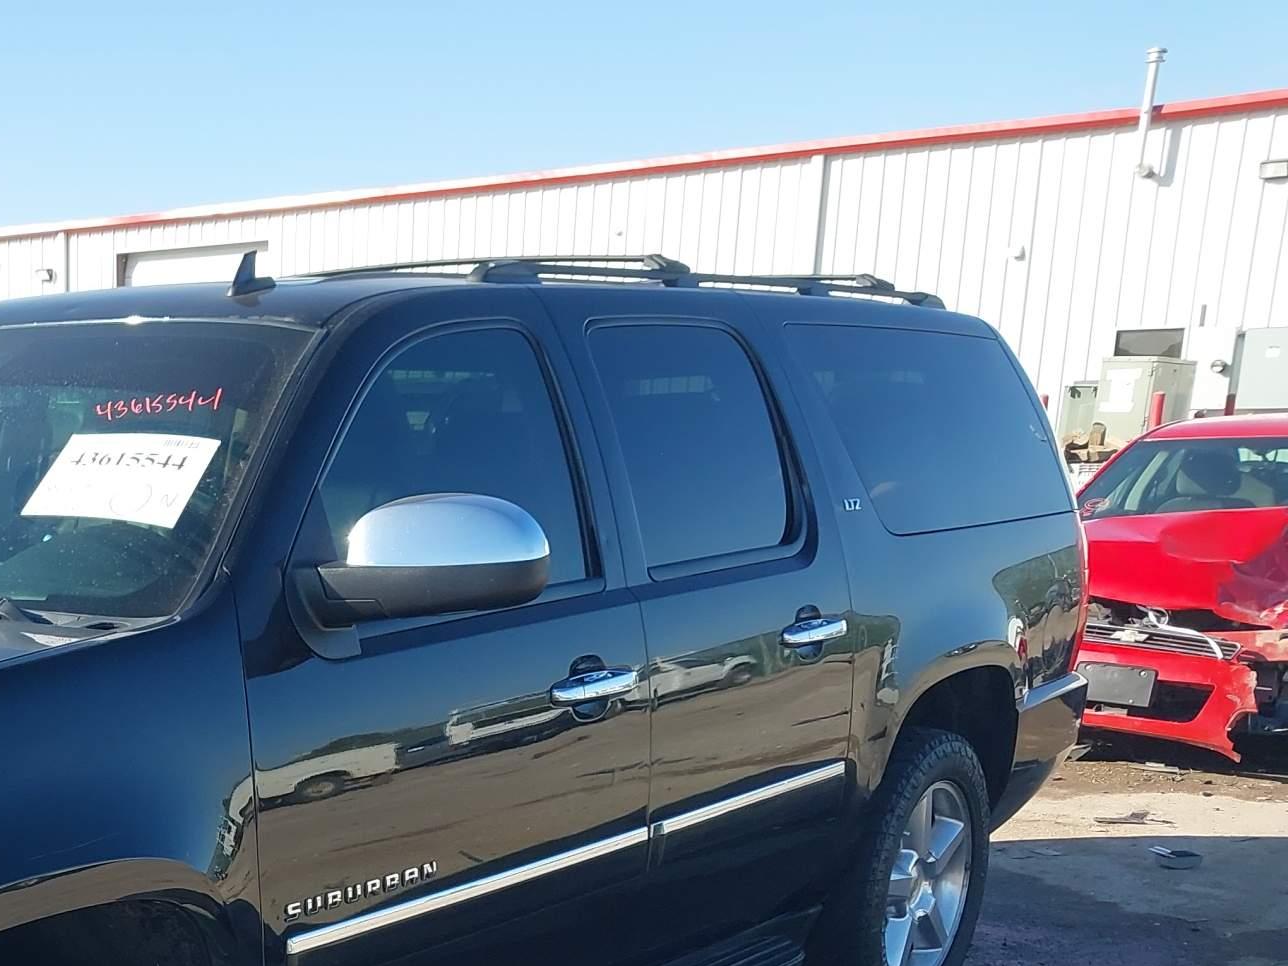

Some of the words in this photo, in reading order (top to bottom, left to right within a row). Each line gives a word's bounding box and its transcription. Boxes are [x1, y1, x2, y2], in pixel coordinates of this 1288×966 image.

[95, 388, 223, 421] 43615544
[843, 498, 862, 511] LTZ
[285, 861, 438, 922] SUBURBAN
